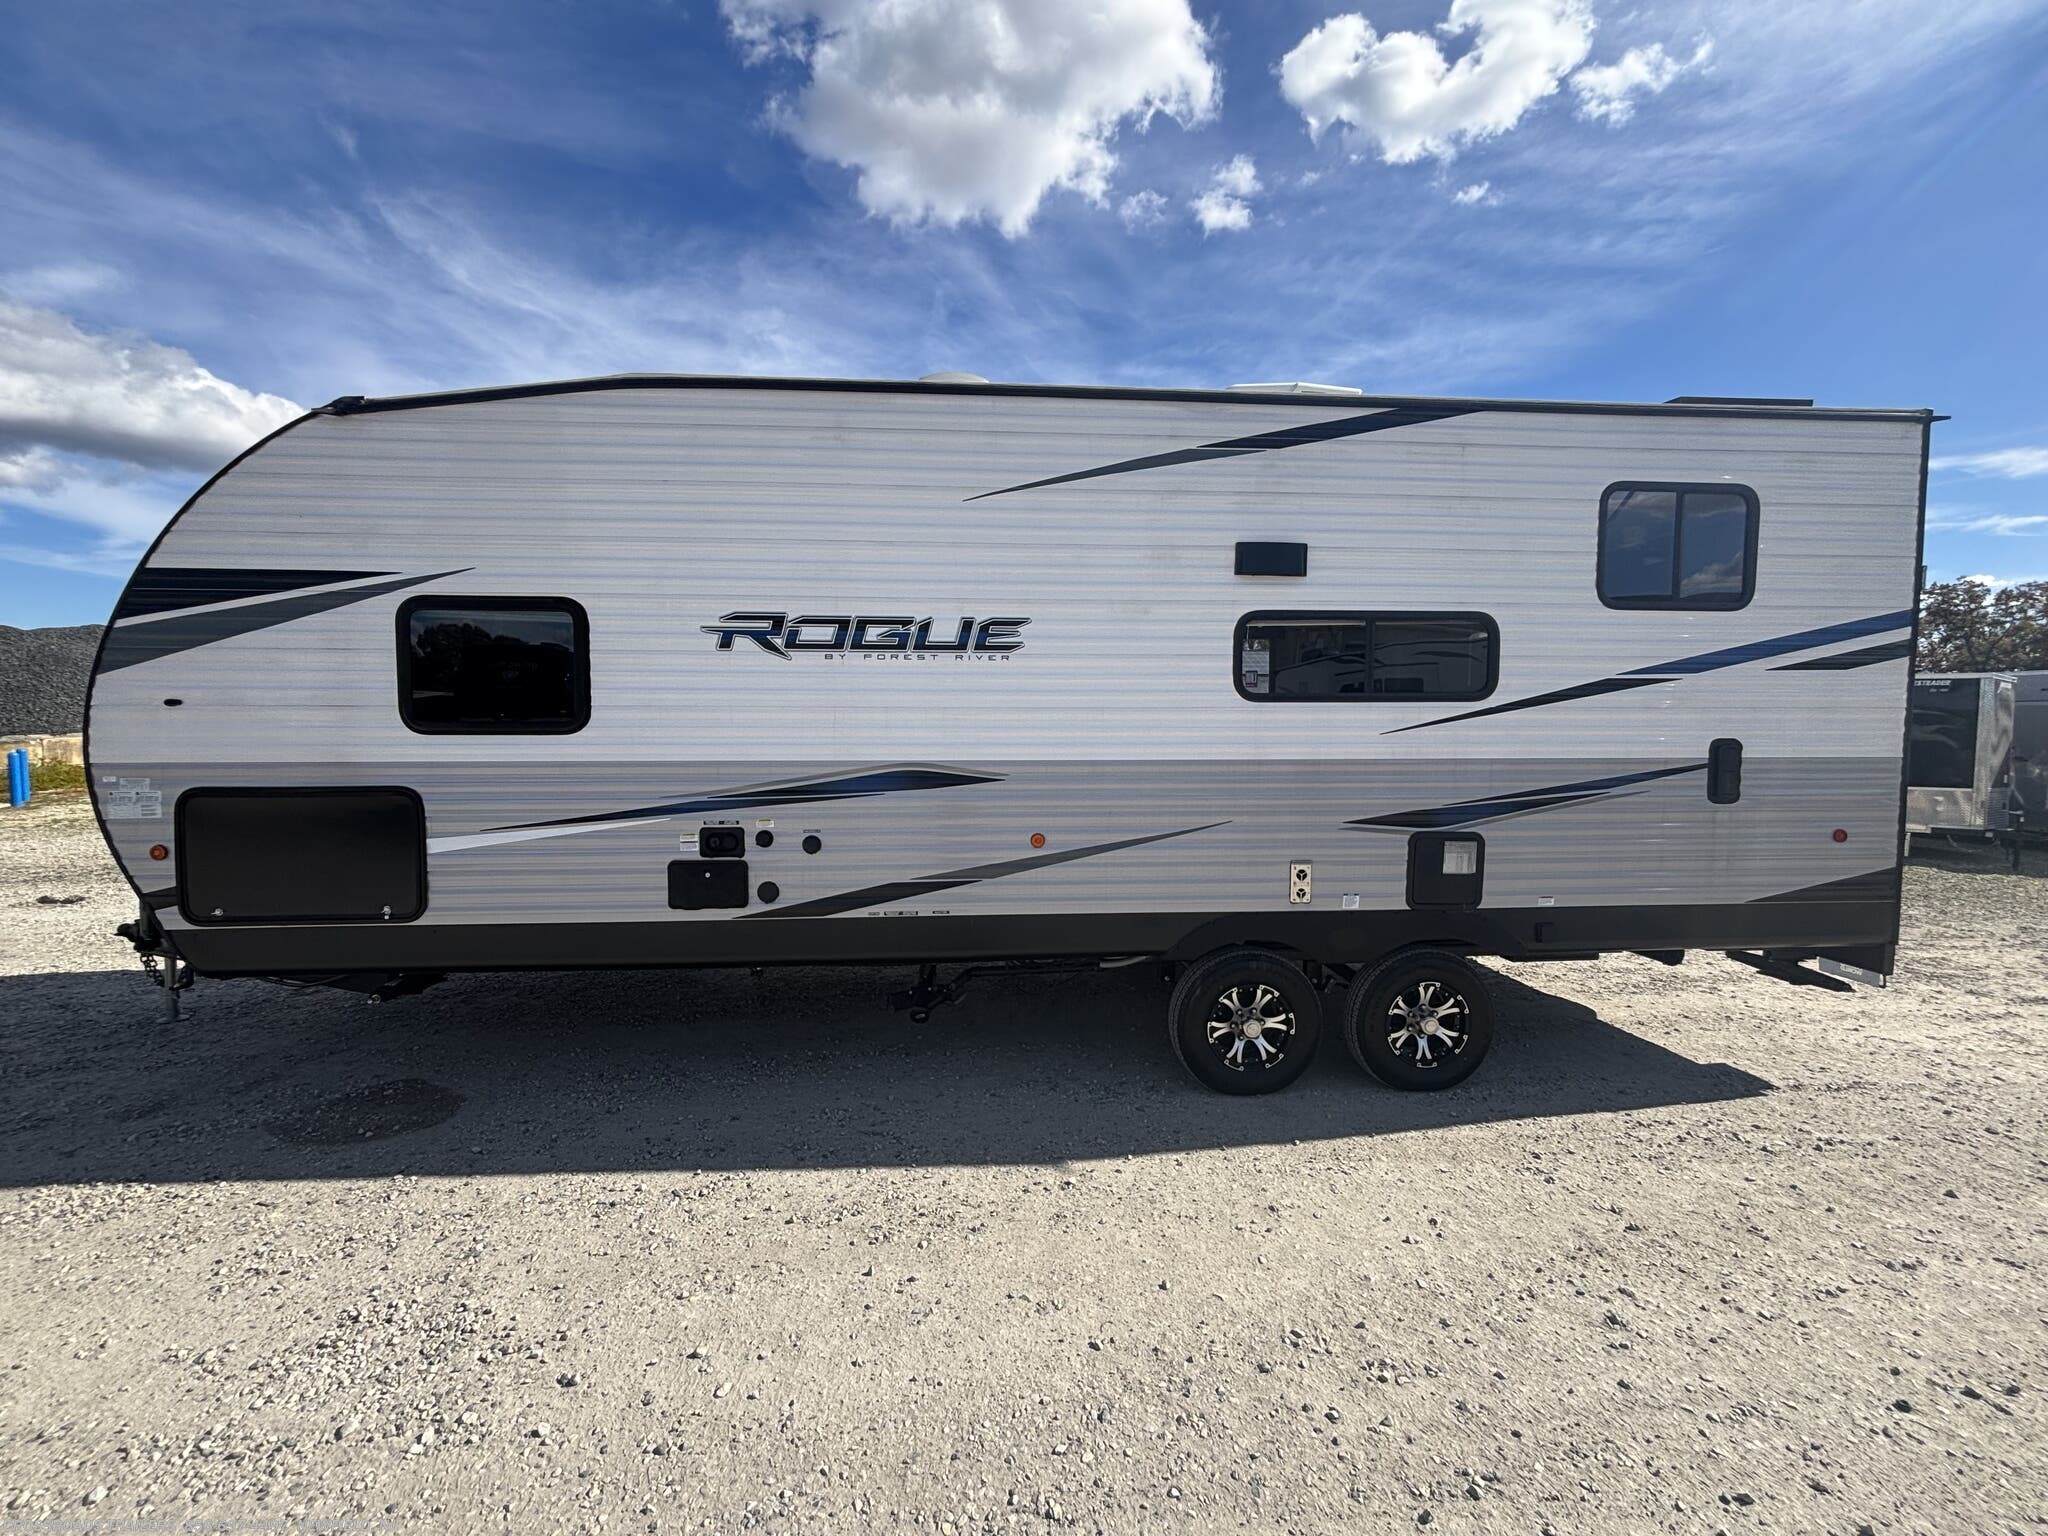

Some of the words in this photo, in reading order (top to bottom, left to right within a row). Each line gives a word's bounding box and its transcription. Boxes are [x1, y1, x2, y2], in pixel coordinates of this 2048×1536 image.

[700, 611, 1032, 660] ROGUE
[824, 653, 846, 661] BY
[863, 653, 939, 661] FOREST
[955, 653, 1010, 661] RIVER
